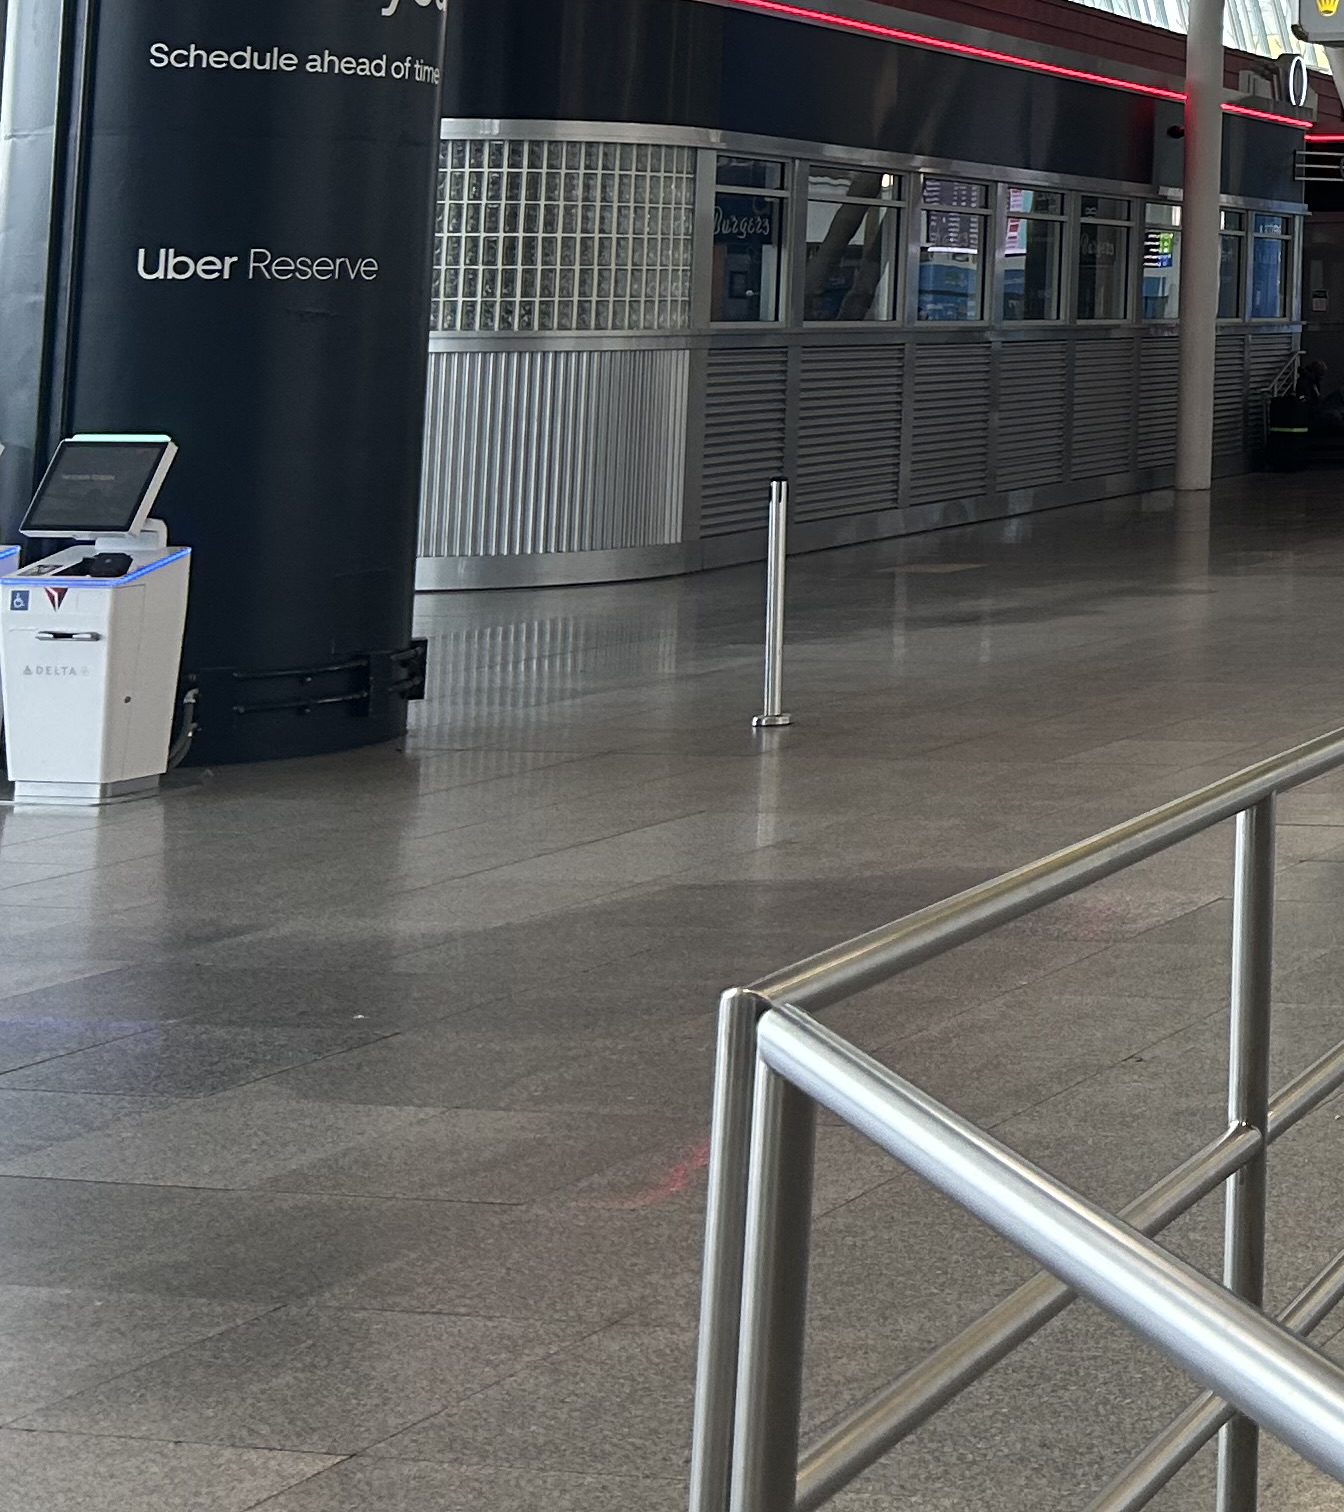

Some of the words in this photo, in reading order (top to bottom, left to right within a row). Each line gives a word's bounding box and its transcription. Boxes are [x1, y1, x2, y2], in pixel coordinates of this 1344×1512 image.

[149, 42, 299, 72] Schedule
[305, 49, 387, 77] ahead
[391, 56, 412, 80] of
[413, 59, 440, 85] time
[138, 248, 239, 280] Uber
[248, 248, 379, 281] Reserve
[35, 666, 77, 676] DELTA
